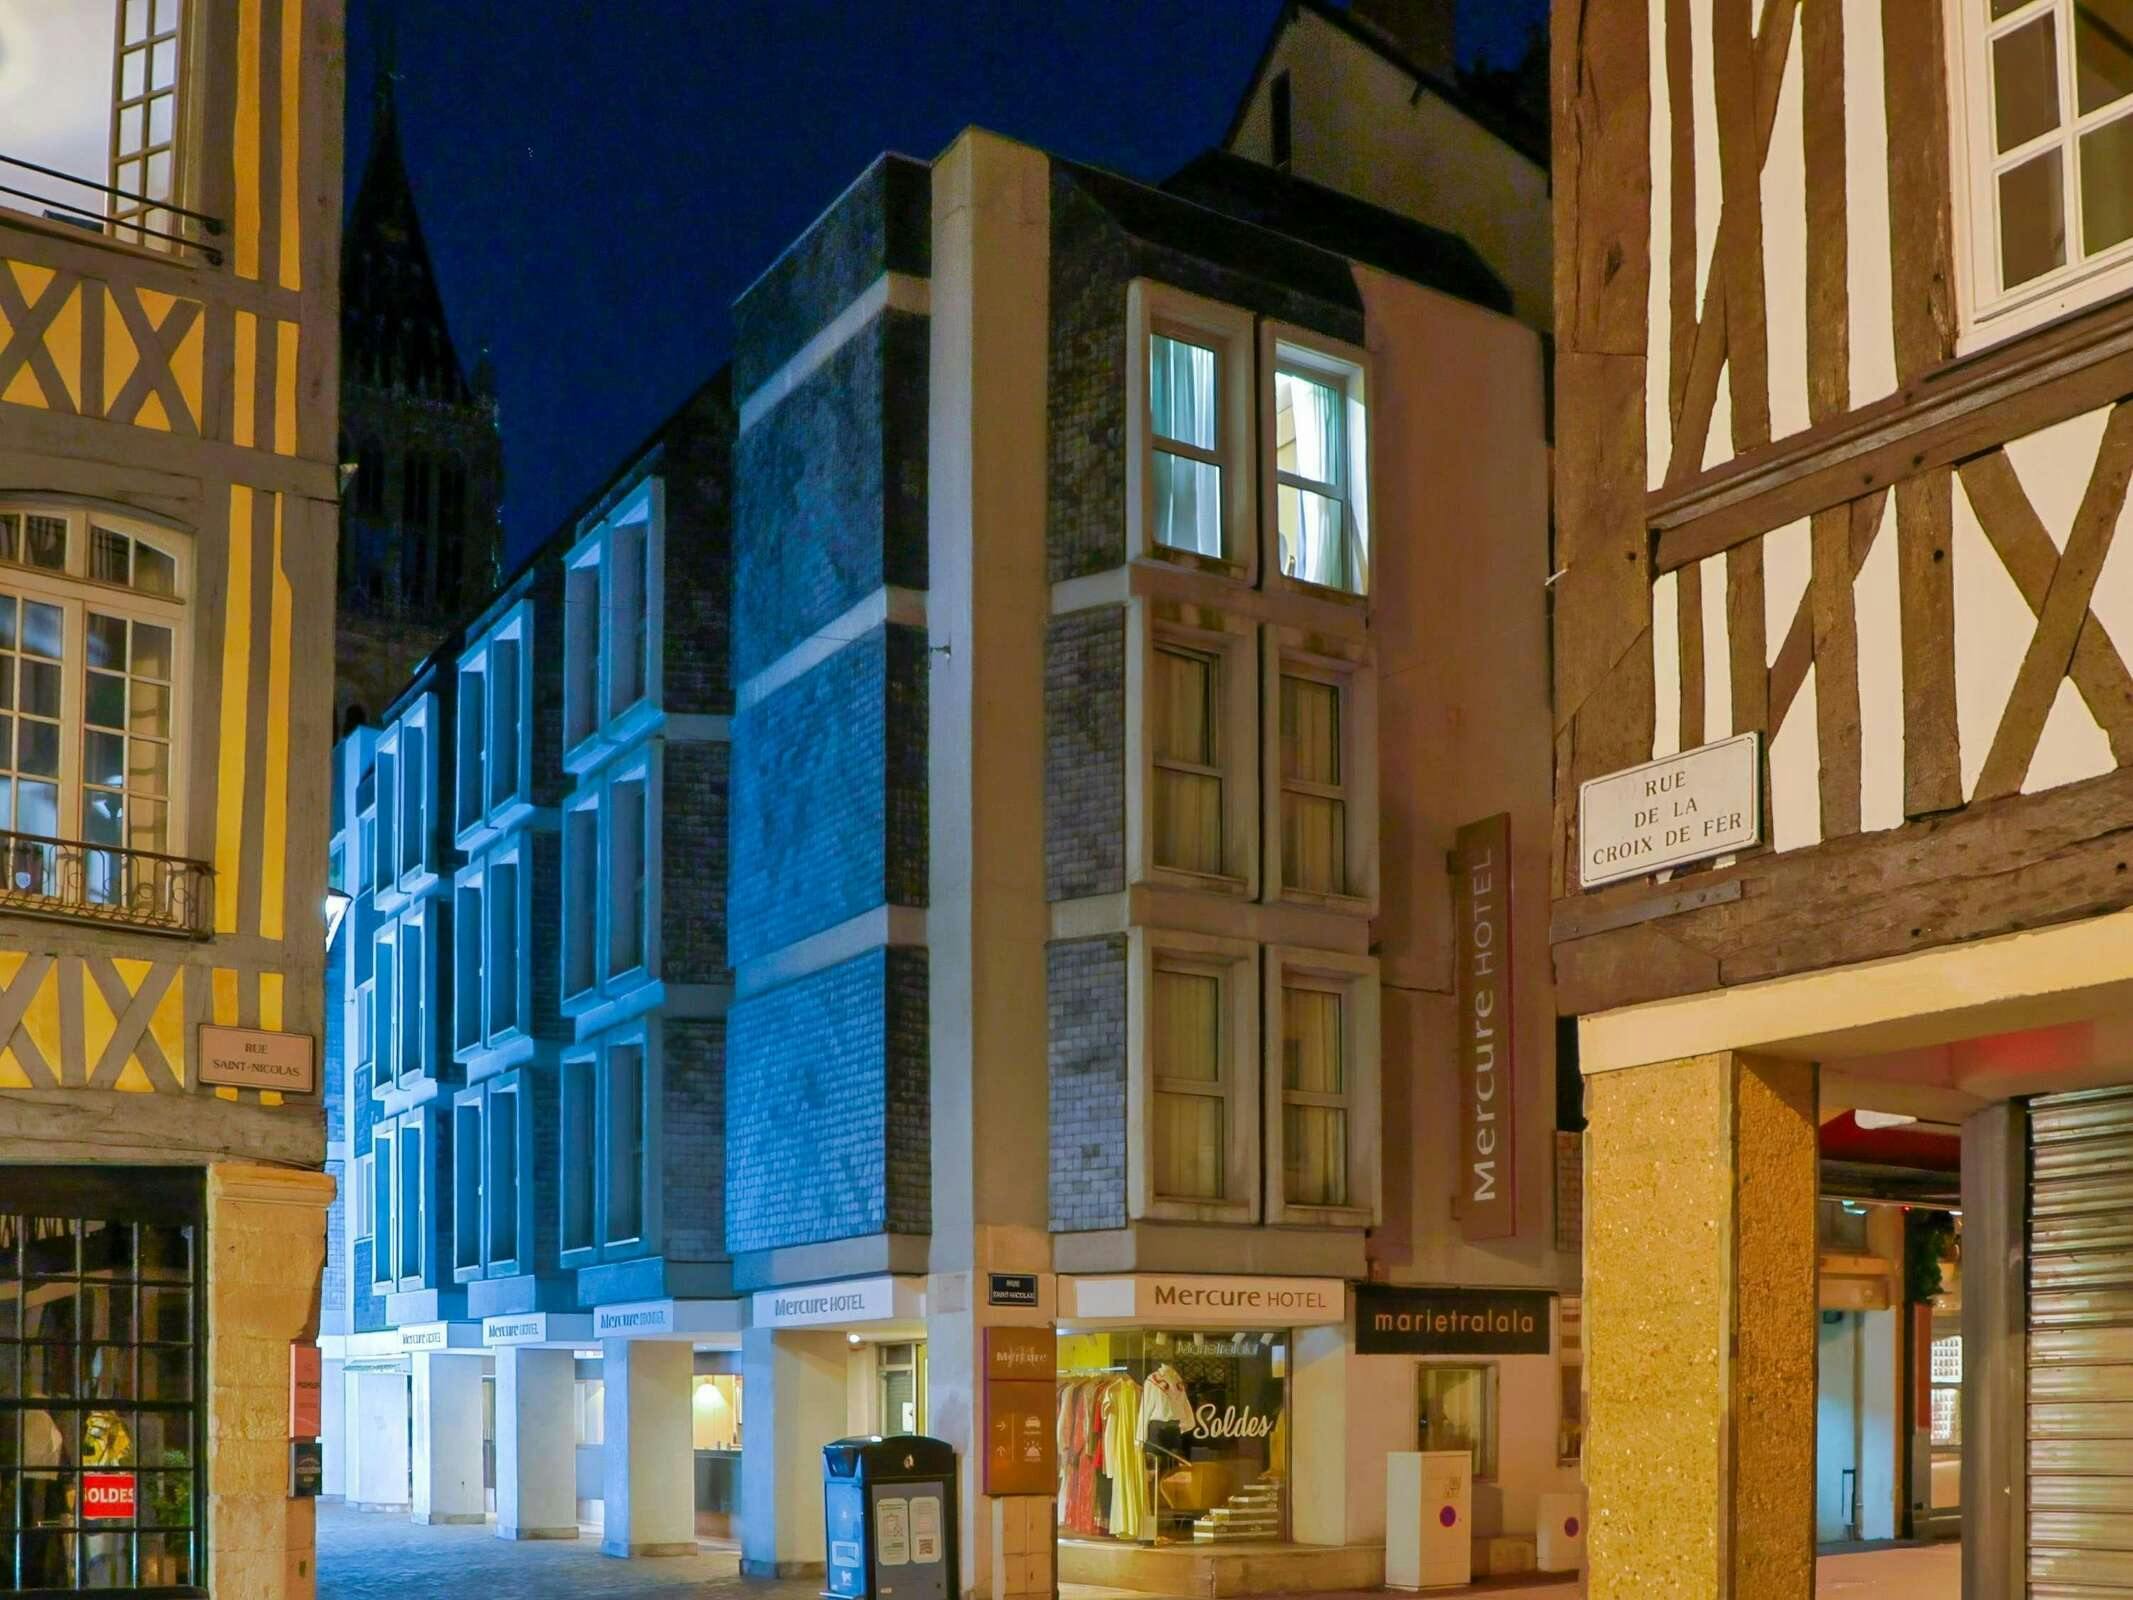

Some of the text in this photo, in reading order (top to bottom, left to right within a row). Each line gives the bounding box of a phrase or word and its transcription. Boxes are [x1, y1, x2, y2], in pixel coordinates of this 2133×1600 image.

[1645, 770, 1687, 798] RUE
[1634, 797, 1698, 829] DE LA
[1593, 812, 1742, 866] CROIX DE FER
[1473, 848, 1496, 1202] Mercure HOTEL
[244, 1042, 269, 1055] RUE
[212, 1059, 301, 1078] SAINT-NICOLAS
[775, 1293, 865, 1317] Mercure HOTEL
[1155, 1285, 1327, 1308] Mercure HOTEL
[601, 1311, 640, 1329] Mercure
[1375, 1308, 1534, 1333] marietralala
[1193, 1403, 1274, 1440] Soldes
[83, 1487, 134, 1504] OLDES
